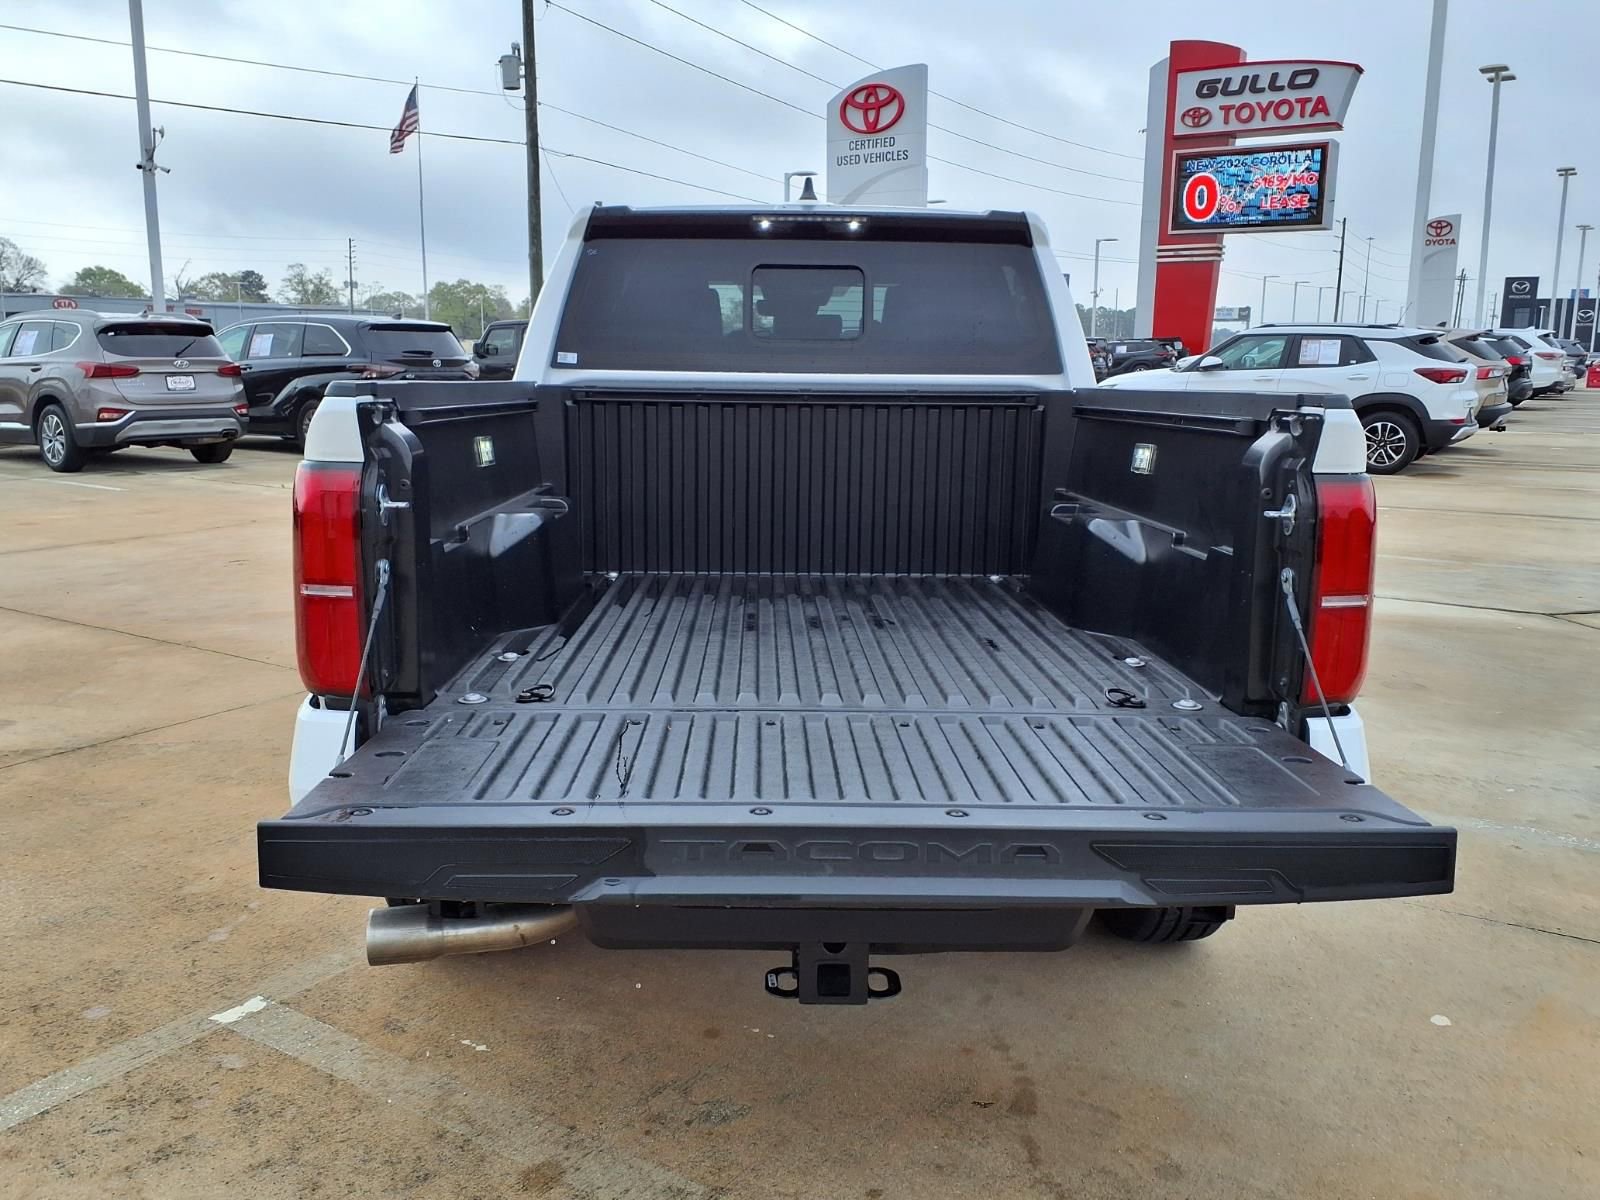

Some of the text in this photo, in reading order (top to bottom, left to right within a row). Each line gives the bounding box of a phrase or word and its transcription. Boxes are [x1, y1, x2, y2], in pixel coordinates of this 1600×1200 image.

[1195, 68, 1320, 99] GULLO
[1219, 95, 1331, 125] TOYOTA
[849, 136, 896, 151] CERTIFIED
[836, 149, 909, 167] USED VEHICLES
[1186, 153, 1314, 173] NEW 2026 COROLLA
[1259, 194, 1310, 210] LEASE
[1424, 238, 1457, 247] OYOTA
[56, 300, 74, 309] KIA
[658, 838, 1062, 866] TACOMA
